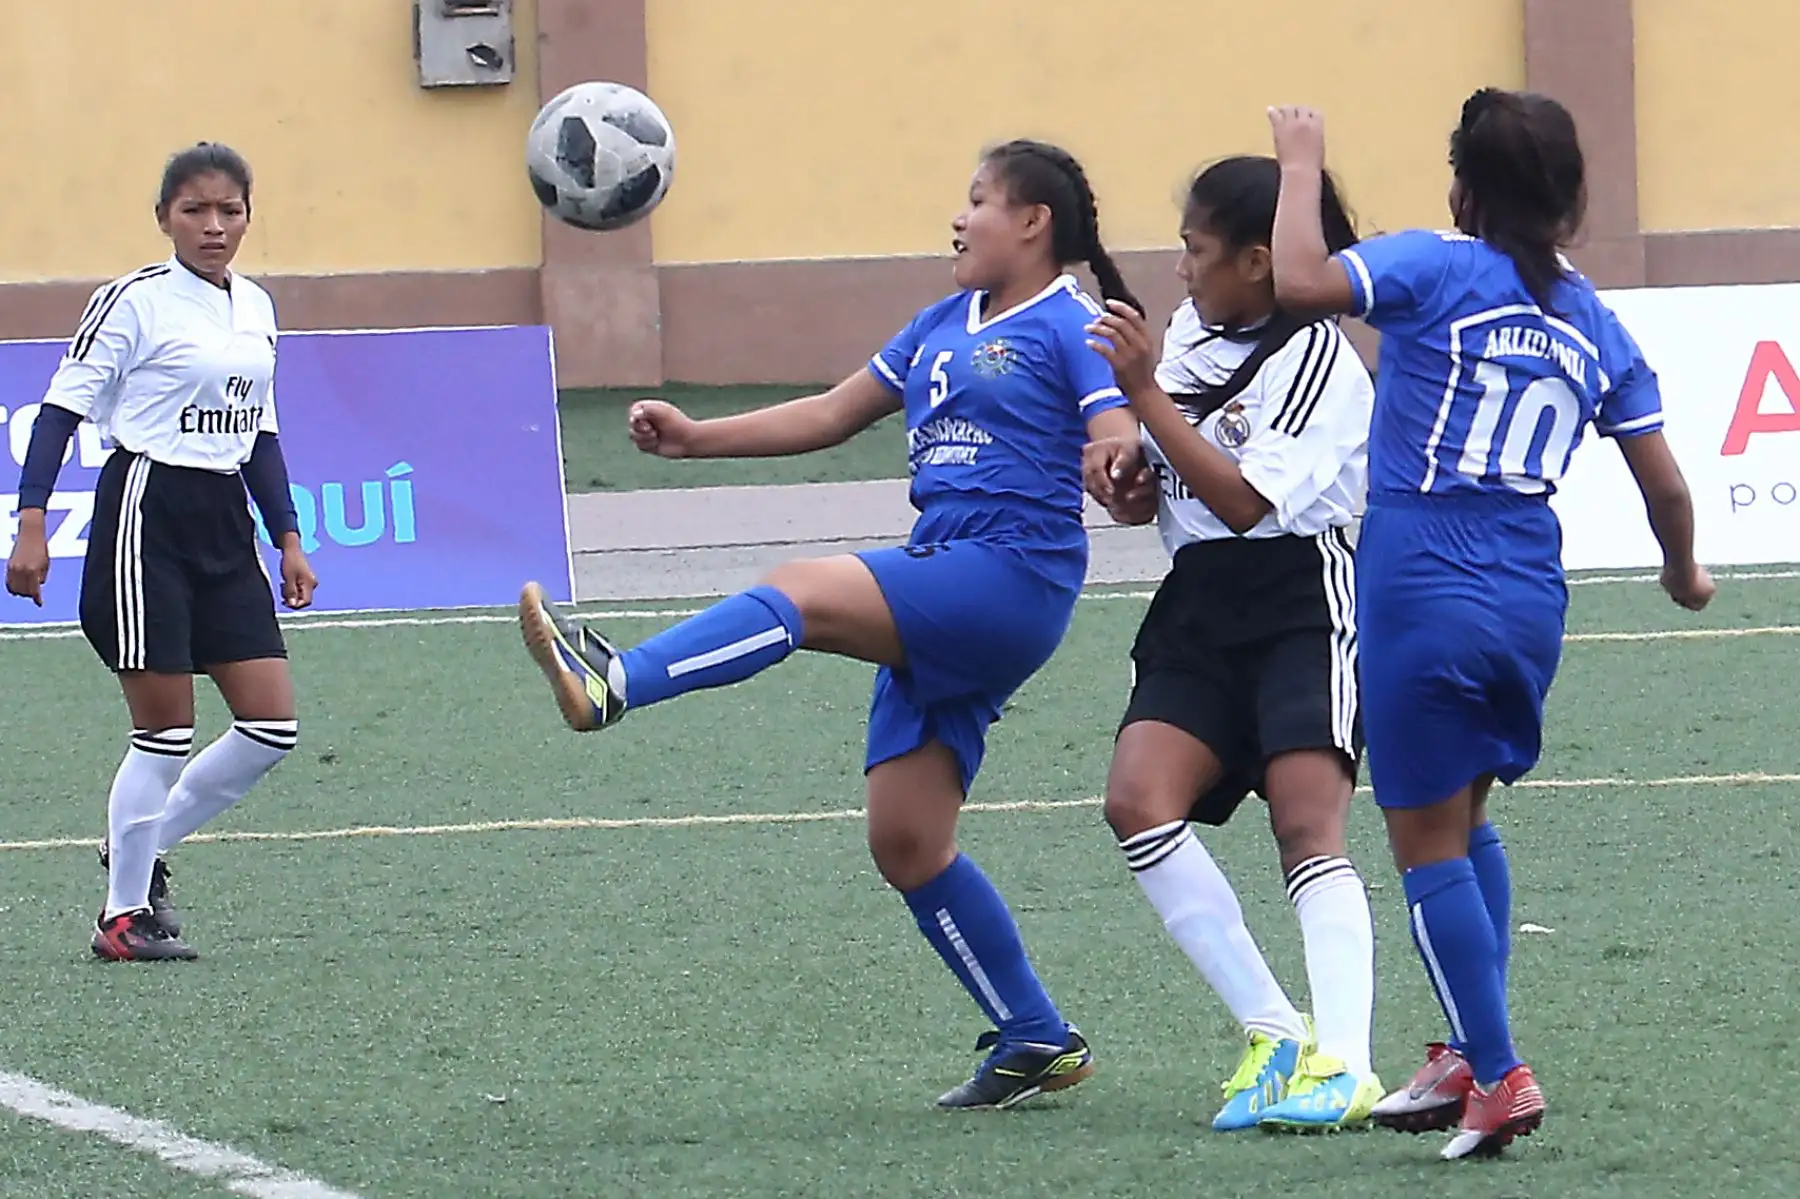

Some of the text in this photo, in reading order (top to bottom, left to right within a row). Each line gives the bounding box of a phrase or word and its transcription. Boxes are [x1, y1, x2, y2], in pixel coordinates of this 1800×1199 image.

[226, 376, 254, 402] Fly
[929, 351, 954, 409] 5
[1456, 361, 1579, 495] 10
[1730, 482, 1797, 513] po
